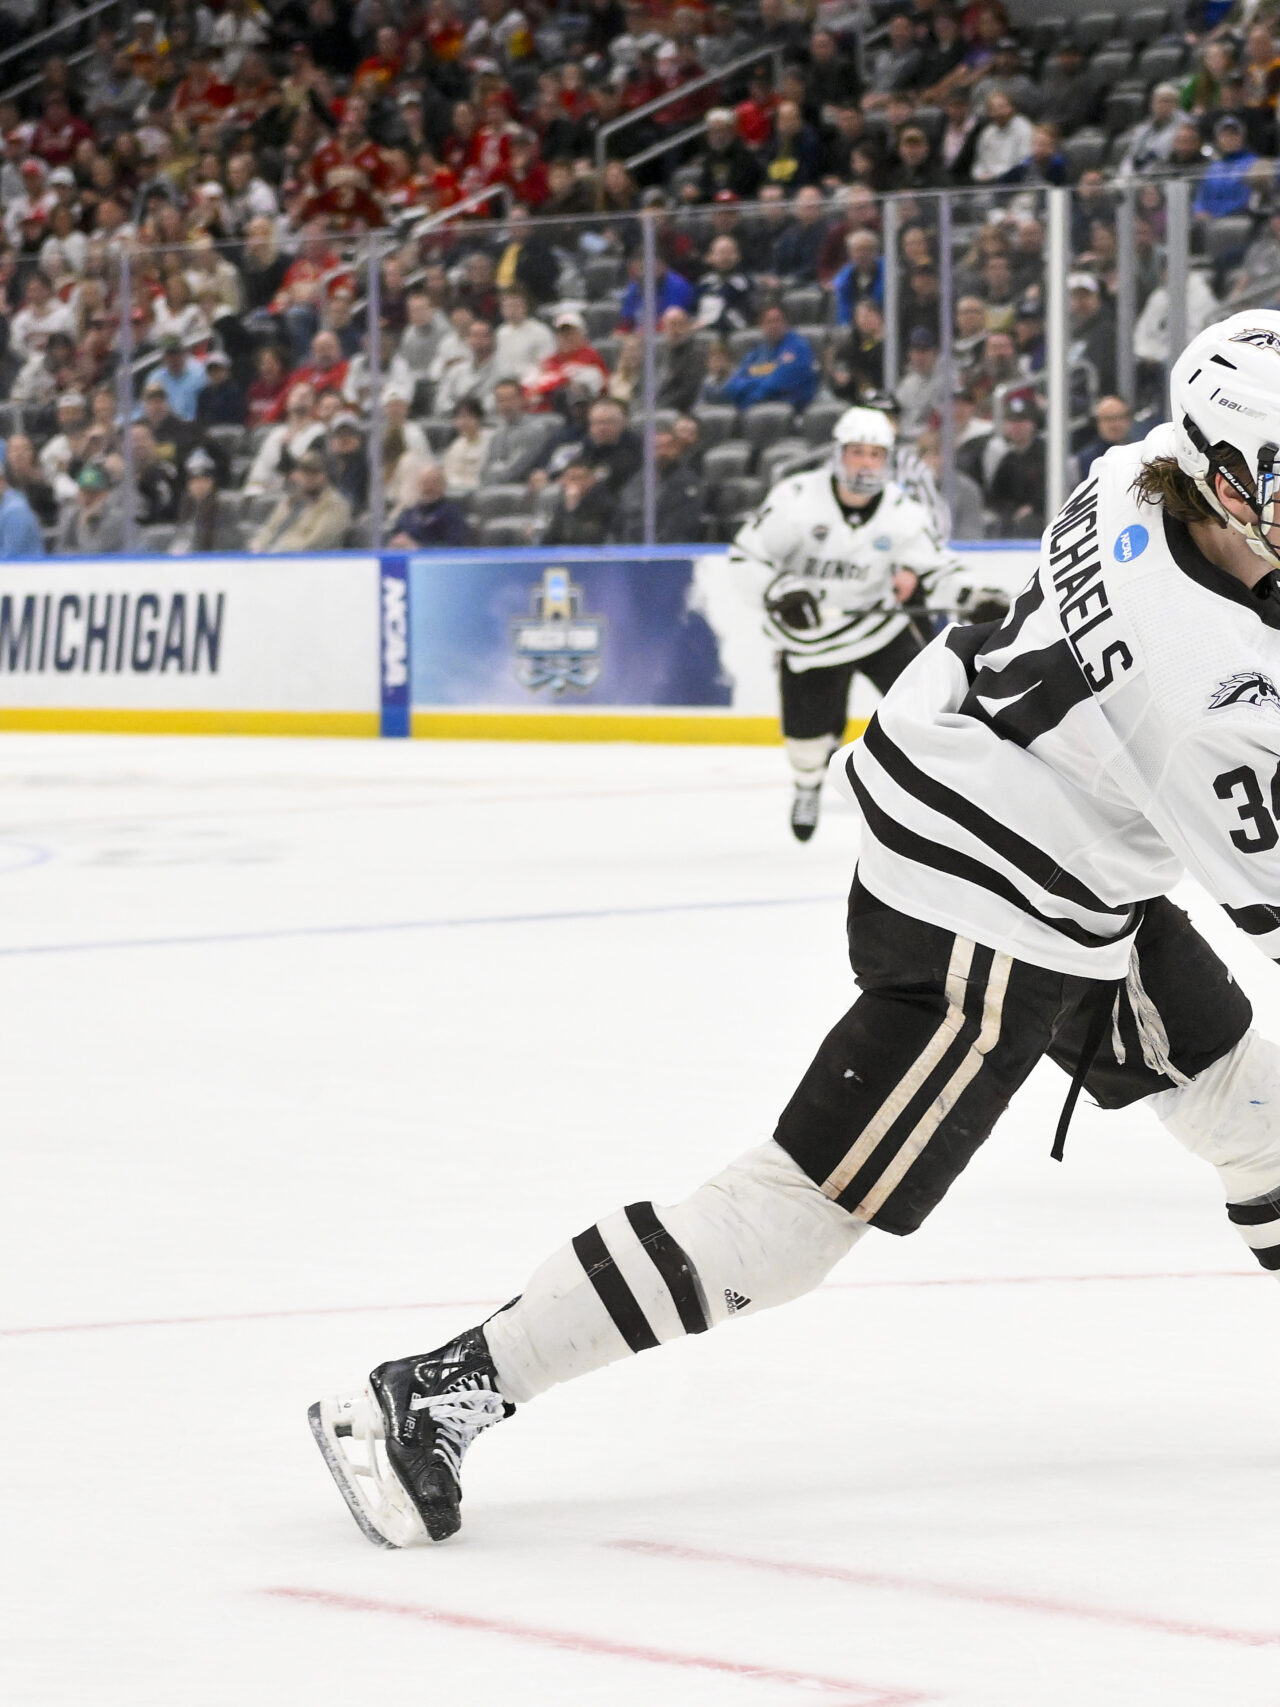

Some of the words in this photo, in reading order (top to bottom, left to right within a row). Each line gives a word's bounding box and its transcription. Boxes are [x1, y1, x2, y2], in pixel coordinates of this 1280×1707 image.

[1049, 476, 1135, 693] MICHAELS
[1120, 531, 1133, 561] NCAA
[0, 592, 226, 673] MICHIGAN
